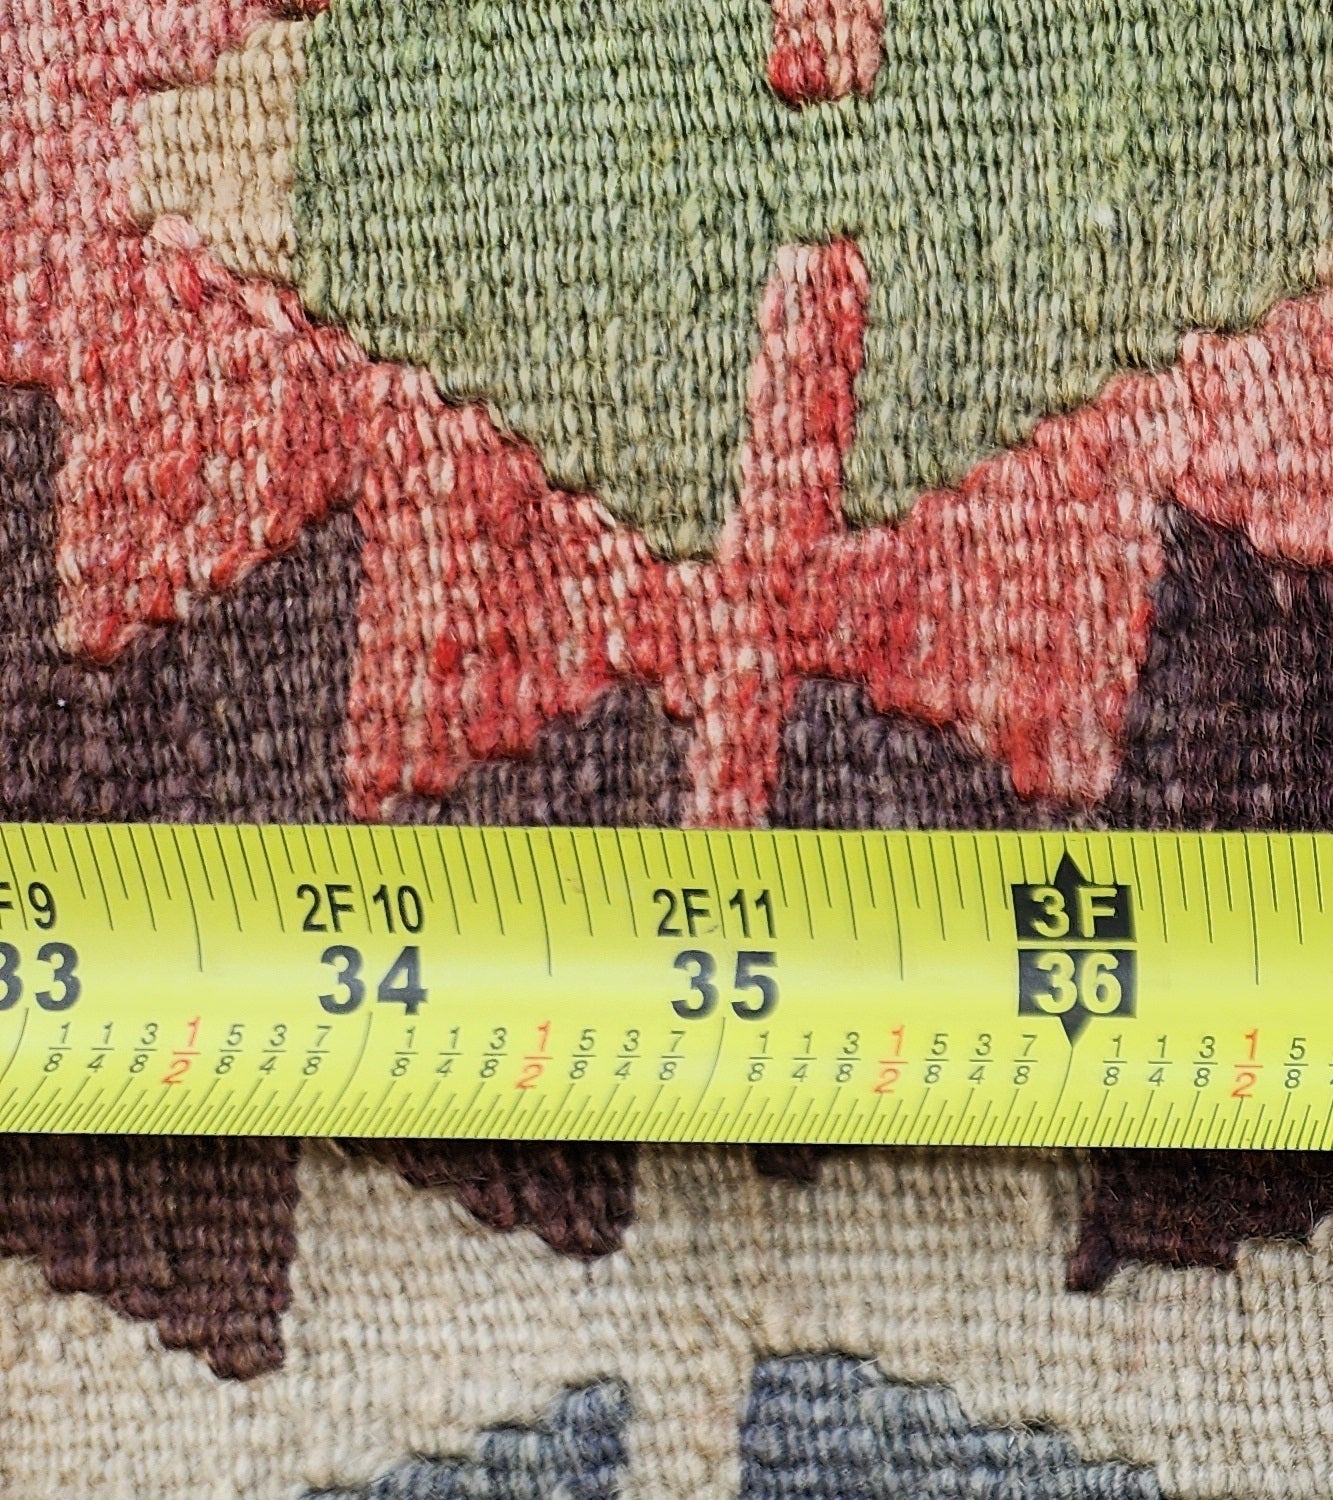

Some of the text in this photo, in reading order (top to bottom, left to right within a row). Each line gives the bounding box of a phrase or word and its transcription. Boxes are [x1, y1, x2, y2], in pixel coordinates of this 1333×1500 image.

[28, 882, 57, 931] 9
[1031, 886, 1117, 938] 3F
[318, 945, 428, 1016] 34
[671, 950, 779, 1021] 35
[1035, 951, 1122, 1015] 36
